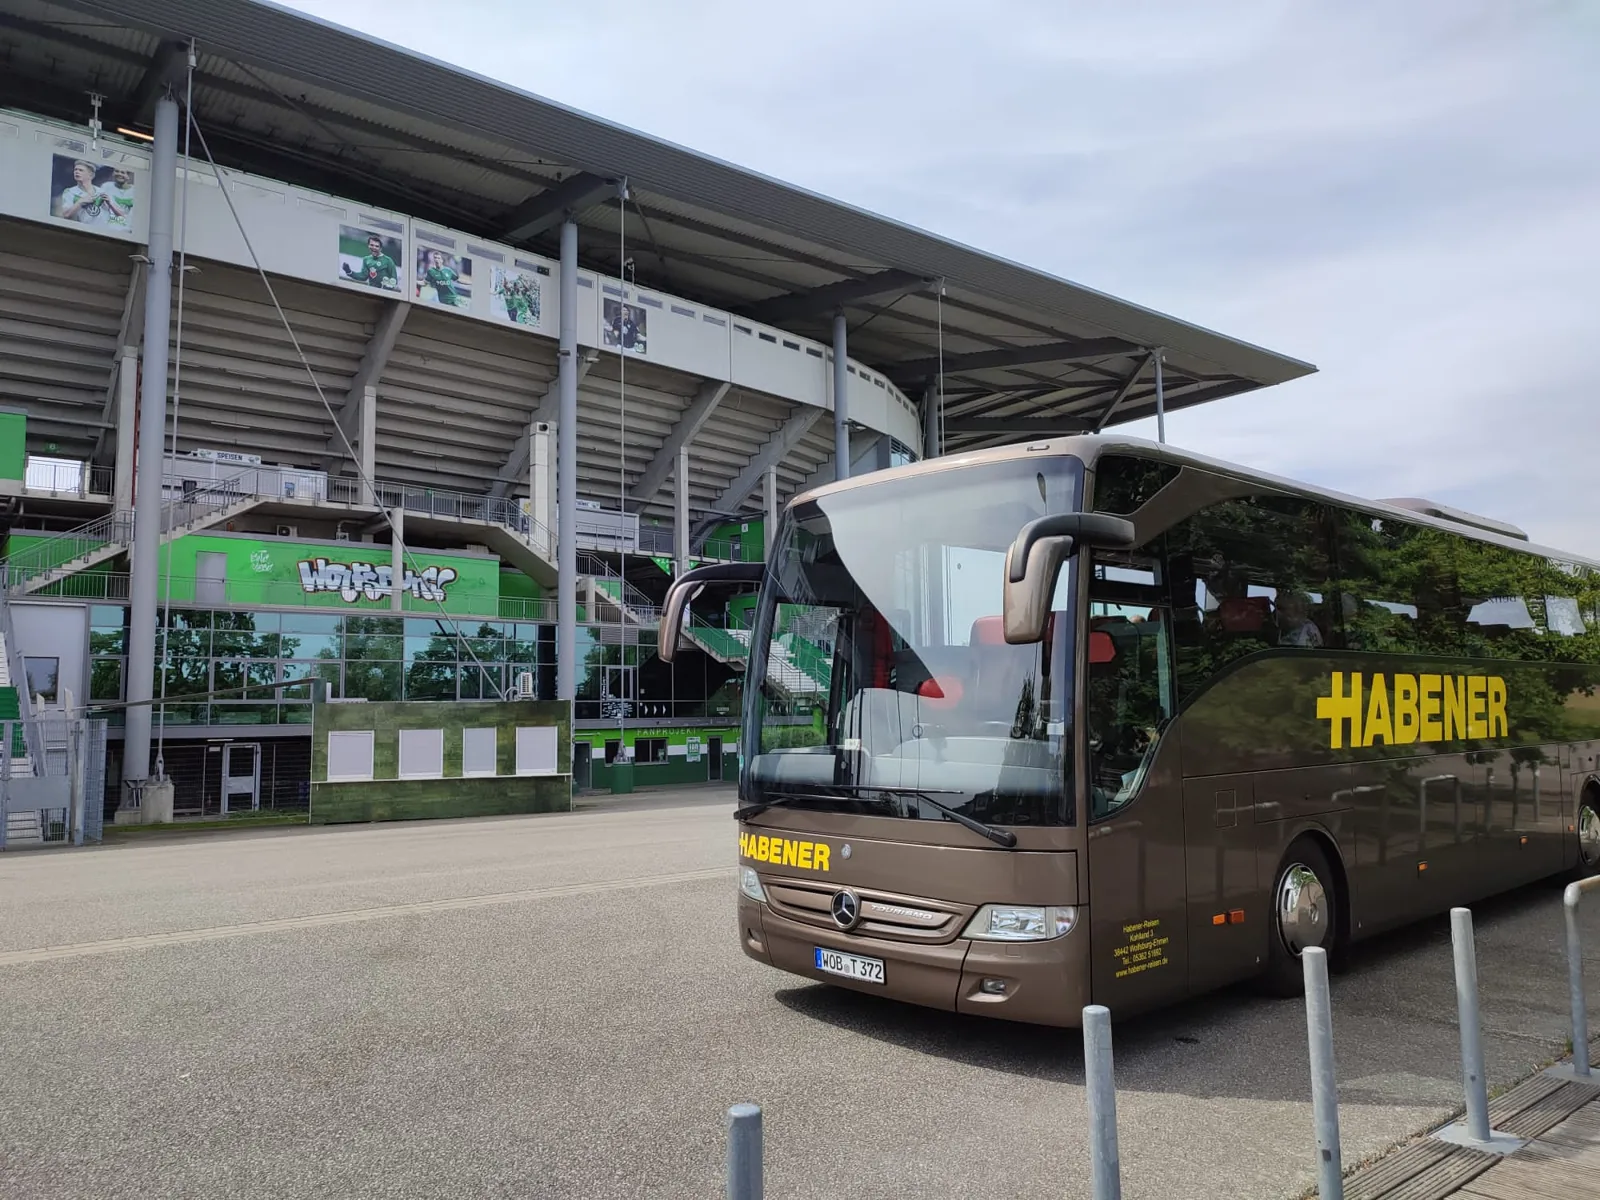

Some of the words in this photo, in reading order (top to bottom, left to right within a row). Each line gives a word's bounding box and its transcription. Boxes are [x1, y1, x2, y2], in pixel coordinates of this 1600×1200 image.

[217, 452, 243, 460] SPEISEN
[1316, 672, 1508, 749] HABENER
[637, 727, 697, 736] FANPROJEKT
[739, 831, 831, 872] HABENER
[871, 904, 933, 919] TOURISMO
[822, 952, 843, 971] WOB
[850, 959, 857, 974] T
[860, 961, 882, 979] 372
